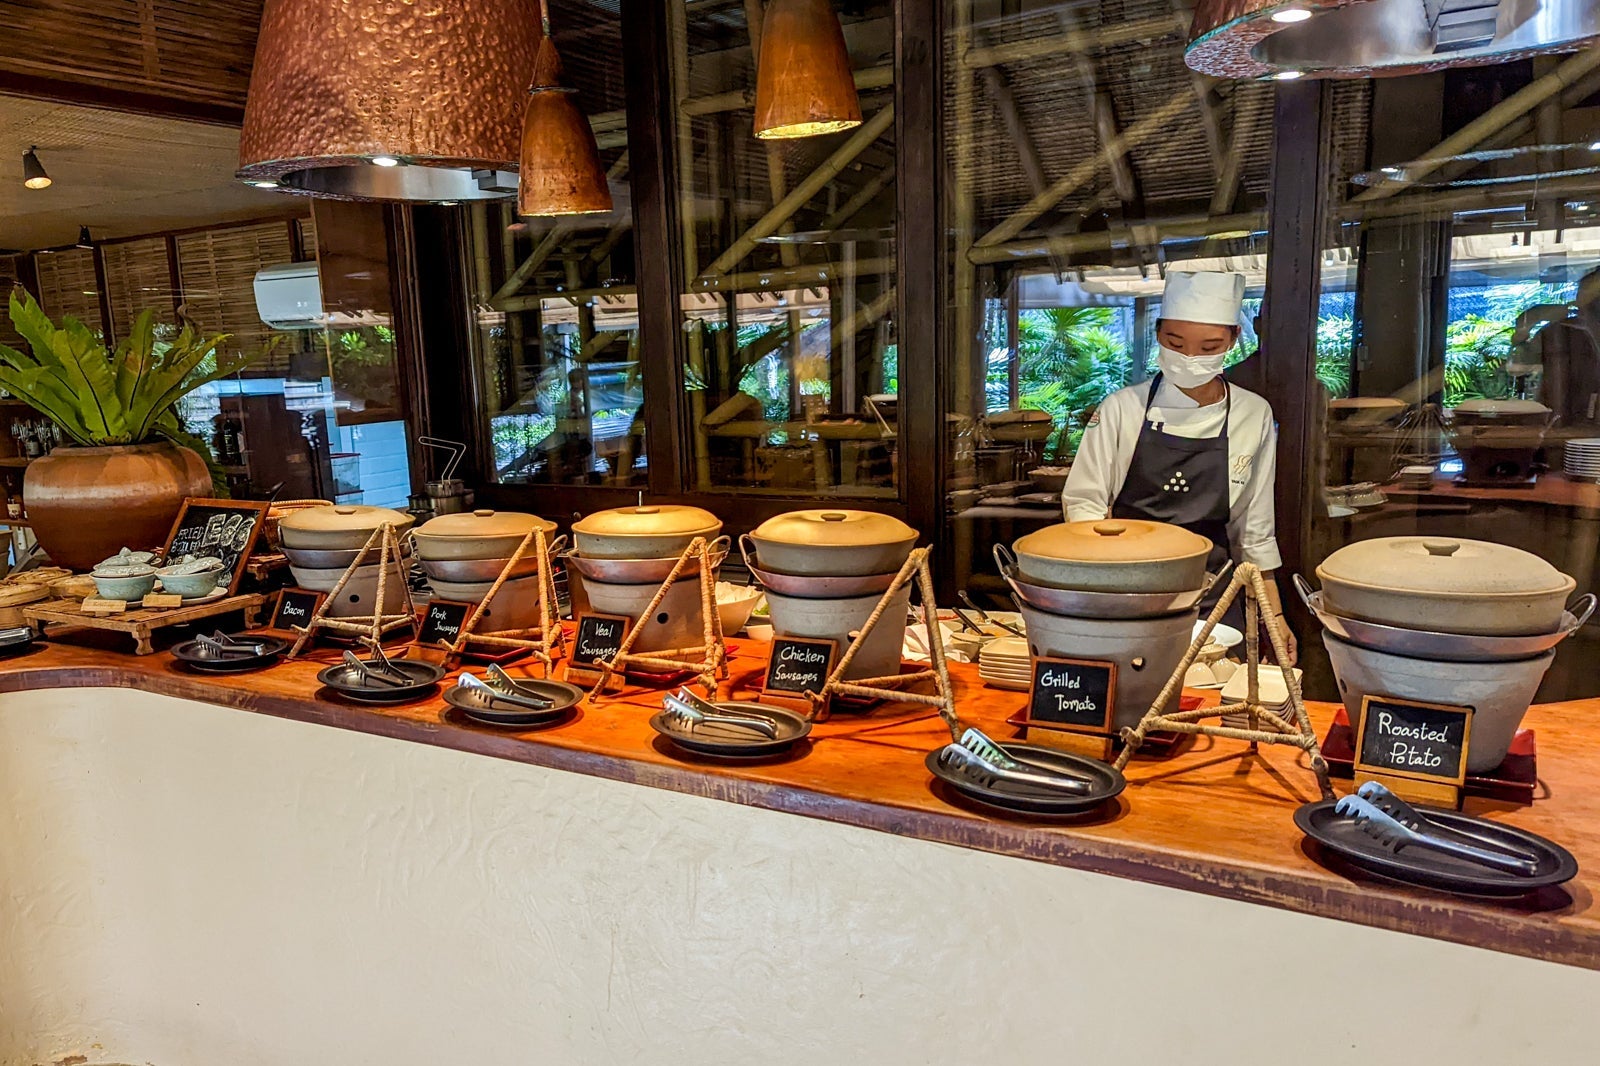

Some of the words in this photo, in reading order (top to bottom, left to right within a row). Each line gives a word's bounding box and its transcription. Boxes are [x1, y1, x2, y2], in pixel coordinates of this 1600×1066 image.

[178, 526, 204, 541] FRIED
[283, 600, 305, 616] Bacon
[430, 607, 447, 620] Pork
[434, 621, 459, 635] Sausages
[595, 622, 614, 638] Veal
[580, 639, 617, 660] Sausages
[780, 646, 825, 664] Chicken
[774, 664, 818, 686] Sausages
[1040, 669, 1081, 689] Grilled
[1054, 694, 1096, 712] Tomato
[1378, 711, 1449, 743] Roasted
[1390, 742, 1441, 767] Potato
